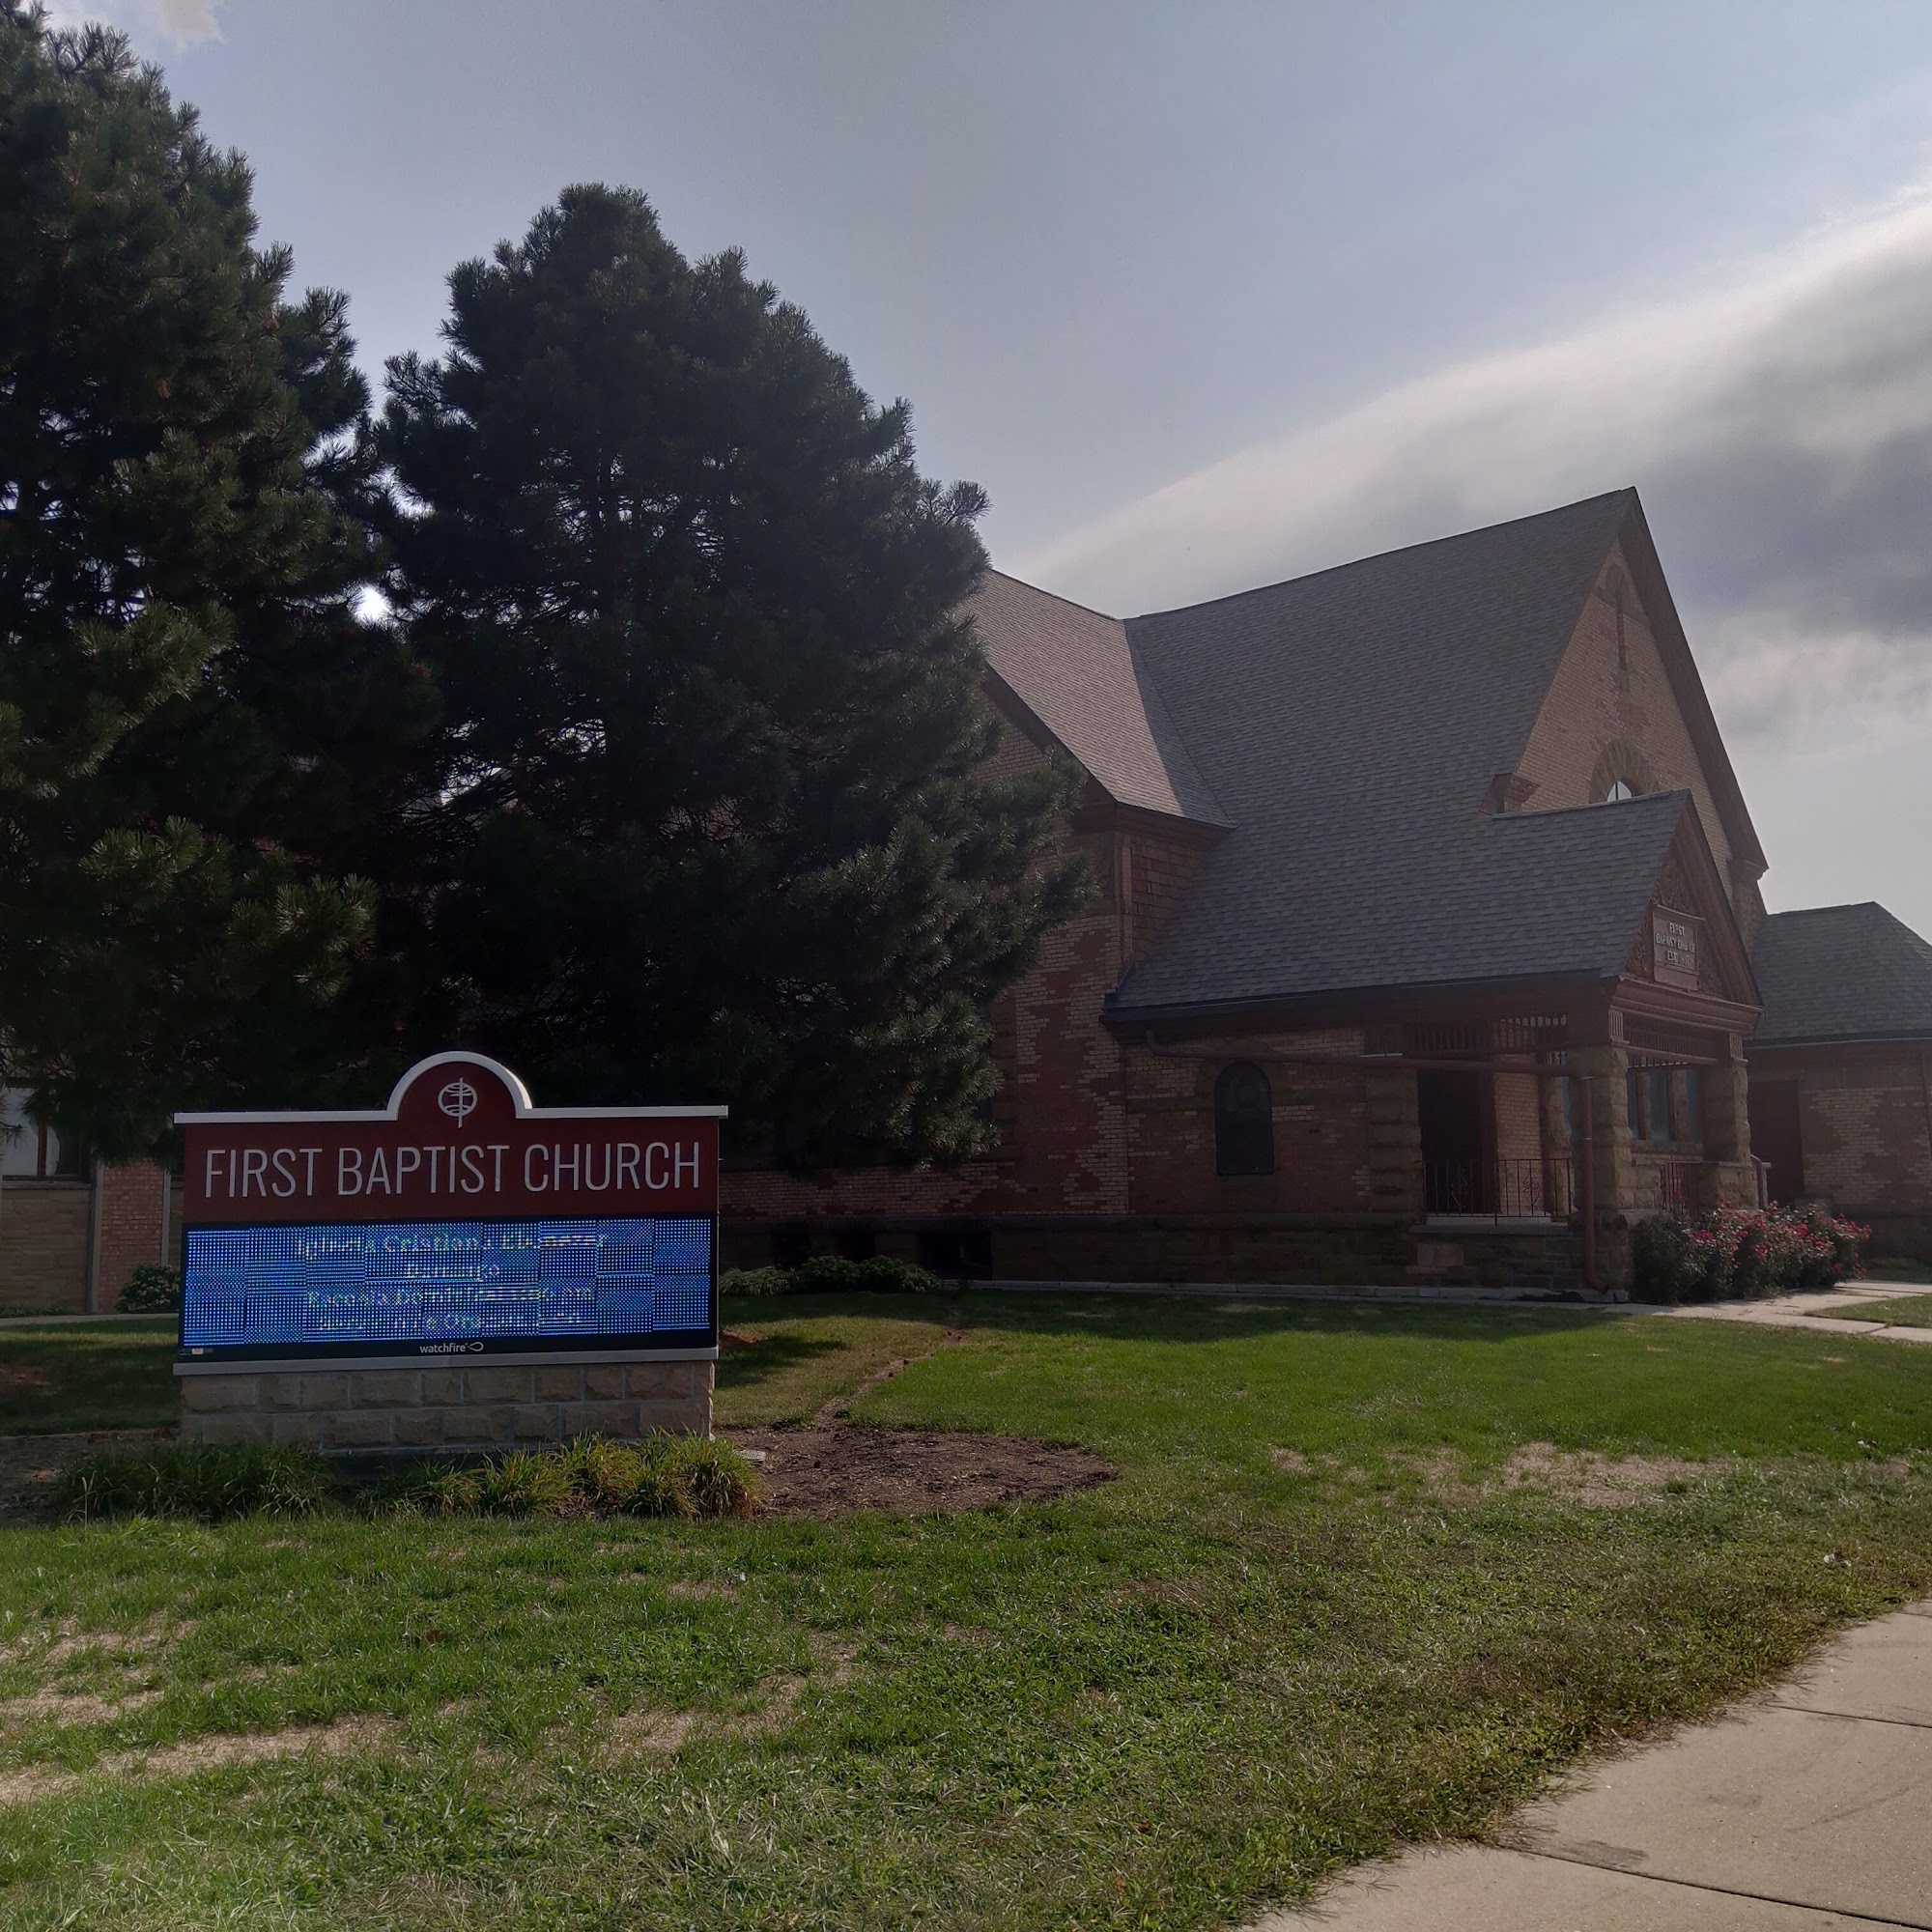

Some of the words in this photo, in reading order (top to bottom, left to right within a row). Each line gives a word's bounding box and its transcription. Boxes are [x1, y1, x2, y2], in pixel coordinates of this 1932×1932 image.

[1677, 939, 1695, 953] CUCH
[205, 1148, 324, 1198] FIRST
[336, 1144, 511, 1197] BAPTIST
[523, 1141, 700, 1193] CHURCH
[382, 1232, 494, 1254] Cristiana
[419, 1342, 467, 1353] watchfire
